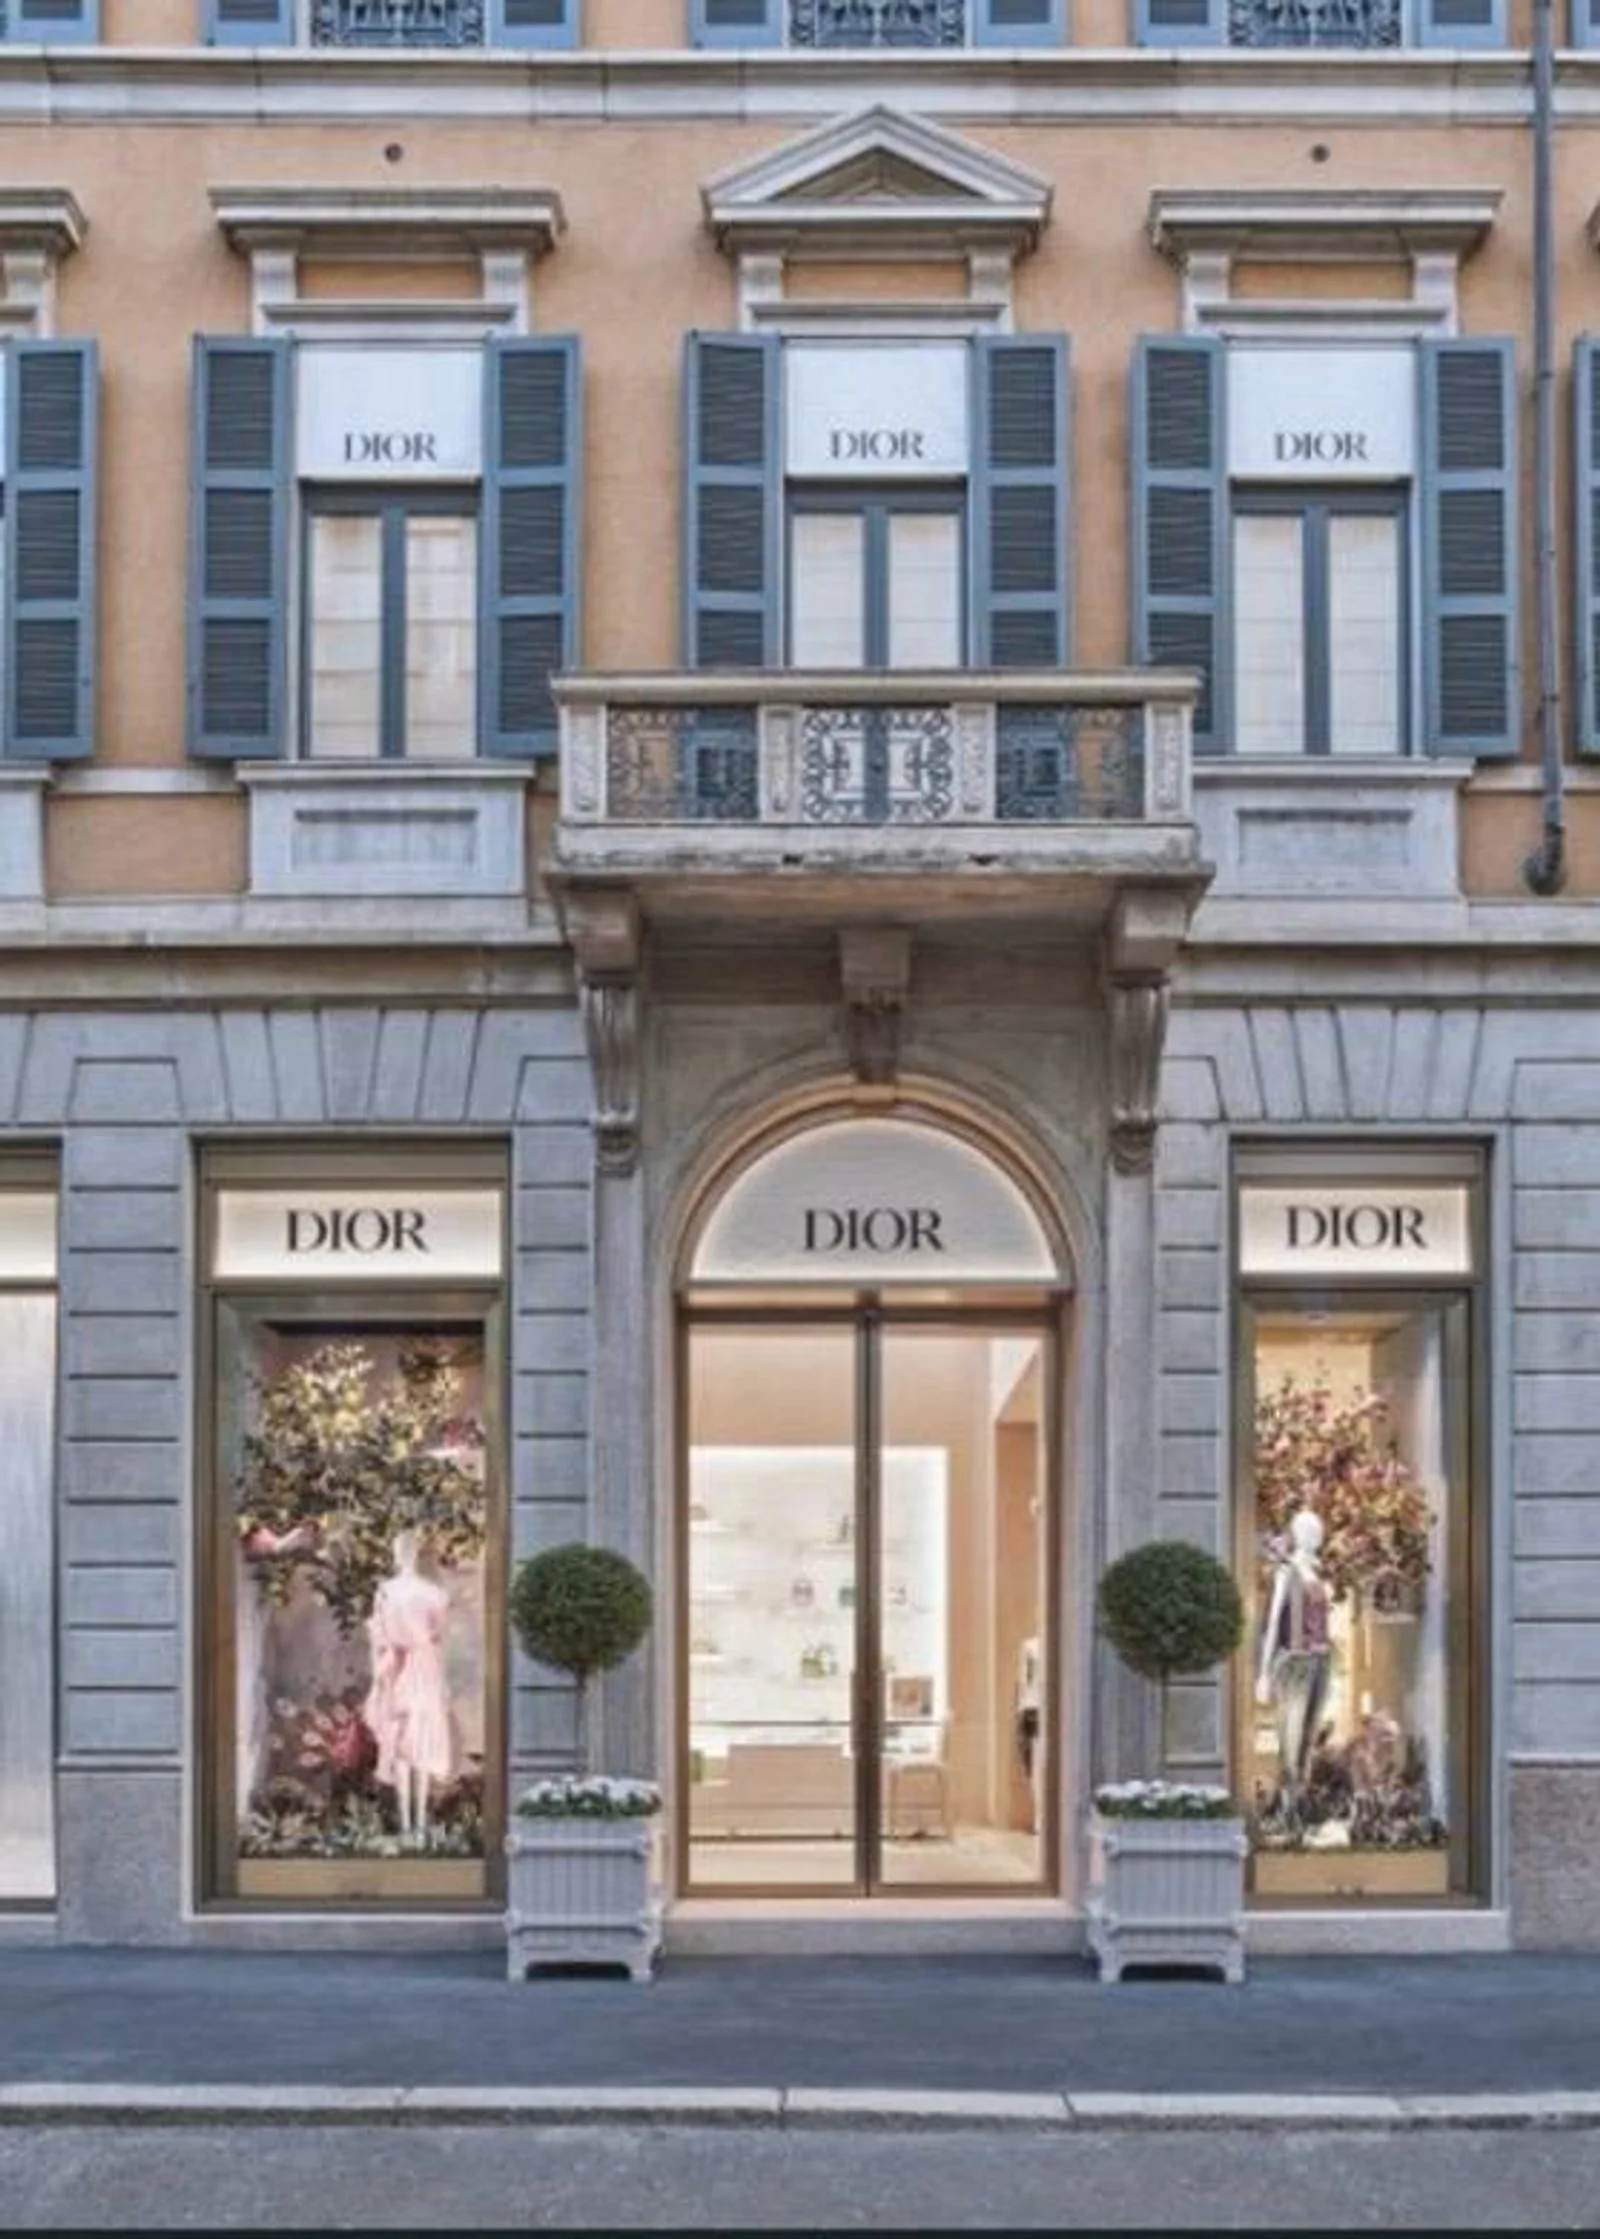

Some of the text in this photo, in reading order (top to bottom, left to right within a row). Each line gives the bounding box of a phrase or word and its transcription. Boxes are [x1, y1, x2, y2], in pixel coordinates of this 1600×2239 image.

[344, 432, 437, 463] DIOR
[830, 430, 924, 460] DIOR
[1275, 432, 1368, 461] DIOR
[286, 1208, 428, 1252] DIOR
[804, 1208, 945, 1251] DIOR
[1286, 1205, 1428, 1249] DIOR
